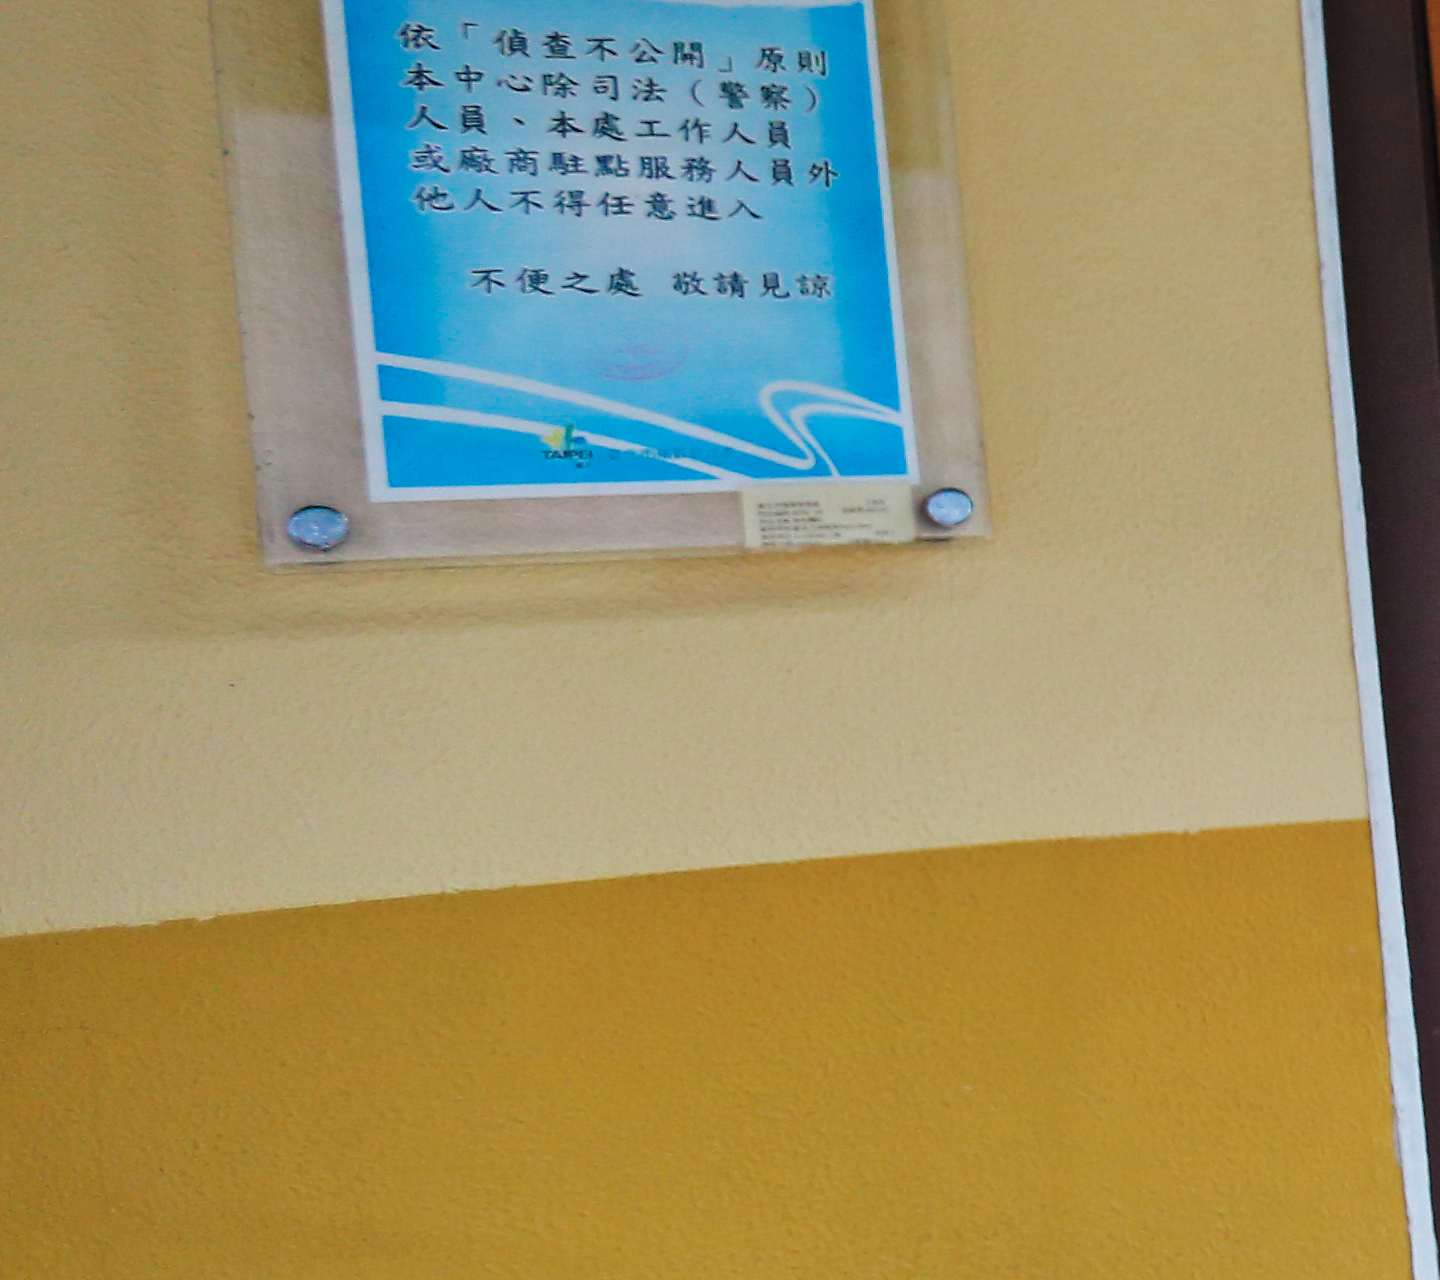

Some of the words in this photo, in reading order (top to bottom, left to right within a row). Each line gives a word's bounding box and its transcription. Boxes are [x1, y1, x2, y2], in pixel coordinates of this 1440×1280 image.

[412, 144, 839, 189] 或廠商駐點服務人員外
[414, 185, 763, 221] 他人不得任意進入
[470, 266, 643, 297] 不便之處
[673, 270, 832, 300] 敬請見諒
